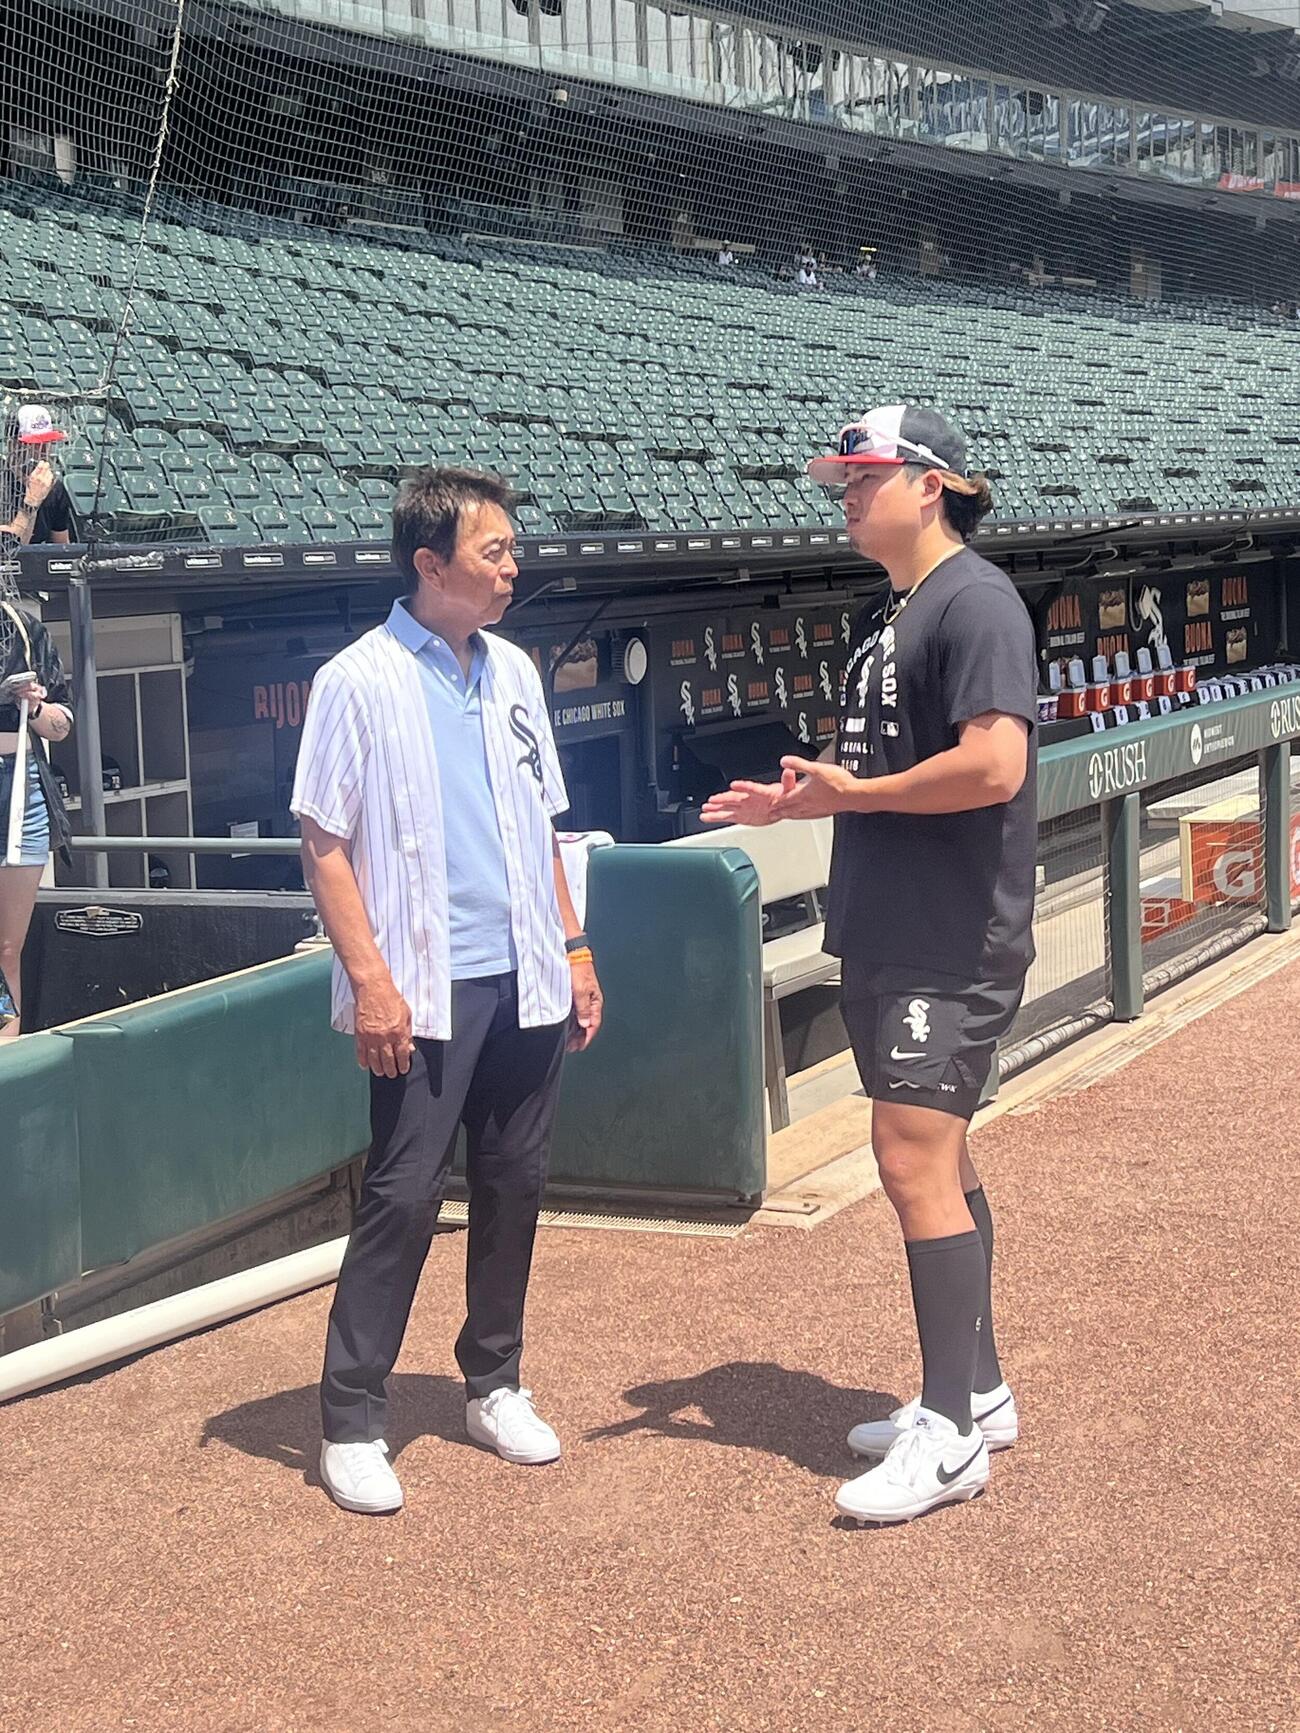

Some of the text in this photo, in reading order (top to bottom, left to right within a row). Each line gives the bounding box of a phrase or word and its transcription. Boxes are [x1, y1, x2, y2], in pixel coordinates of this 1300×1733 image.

[562, 705, 590, 726] CHICAGO
[591, 701, 611, 720] WHITE
[612, 700, 625, 717] SOX
[1280, 695, 1300, 735] RUS
[1104, 740, 1147, 793] RUSH
[1213, 851, 1255, 897] G
